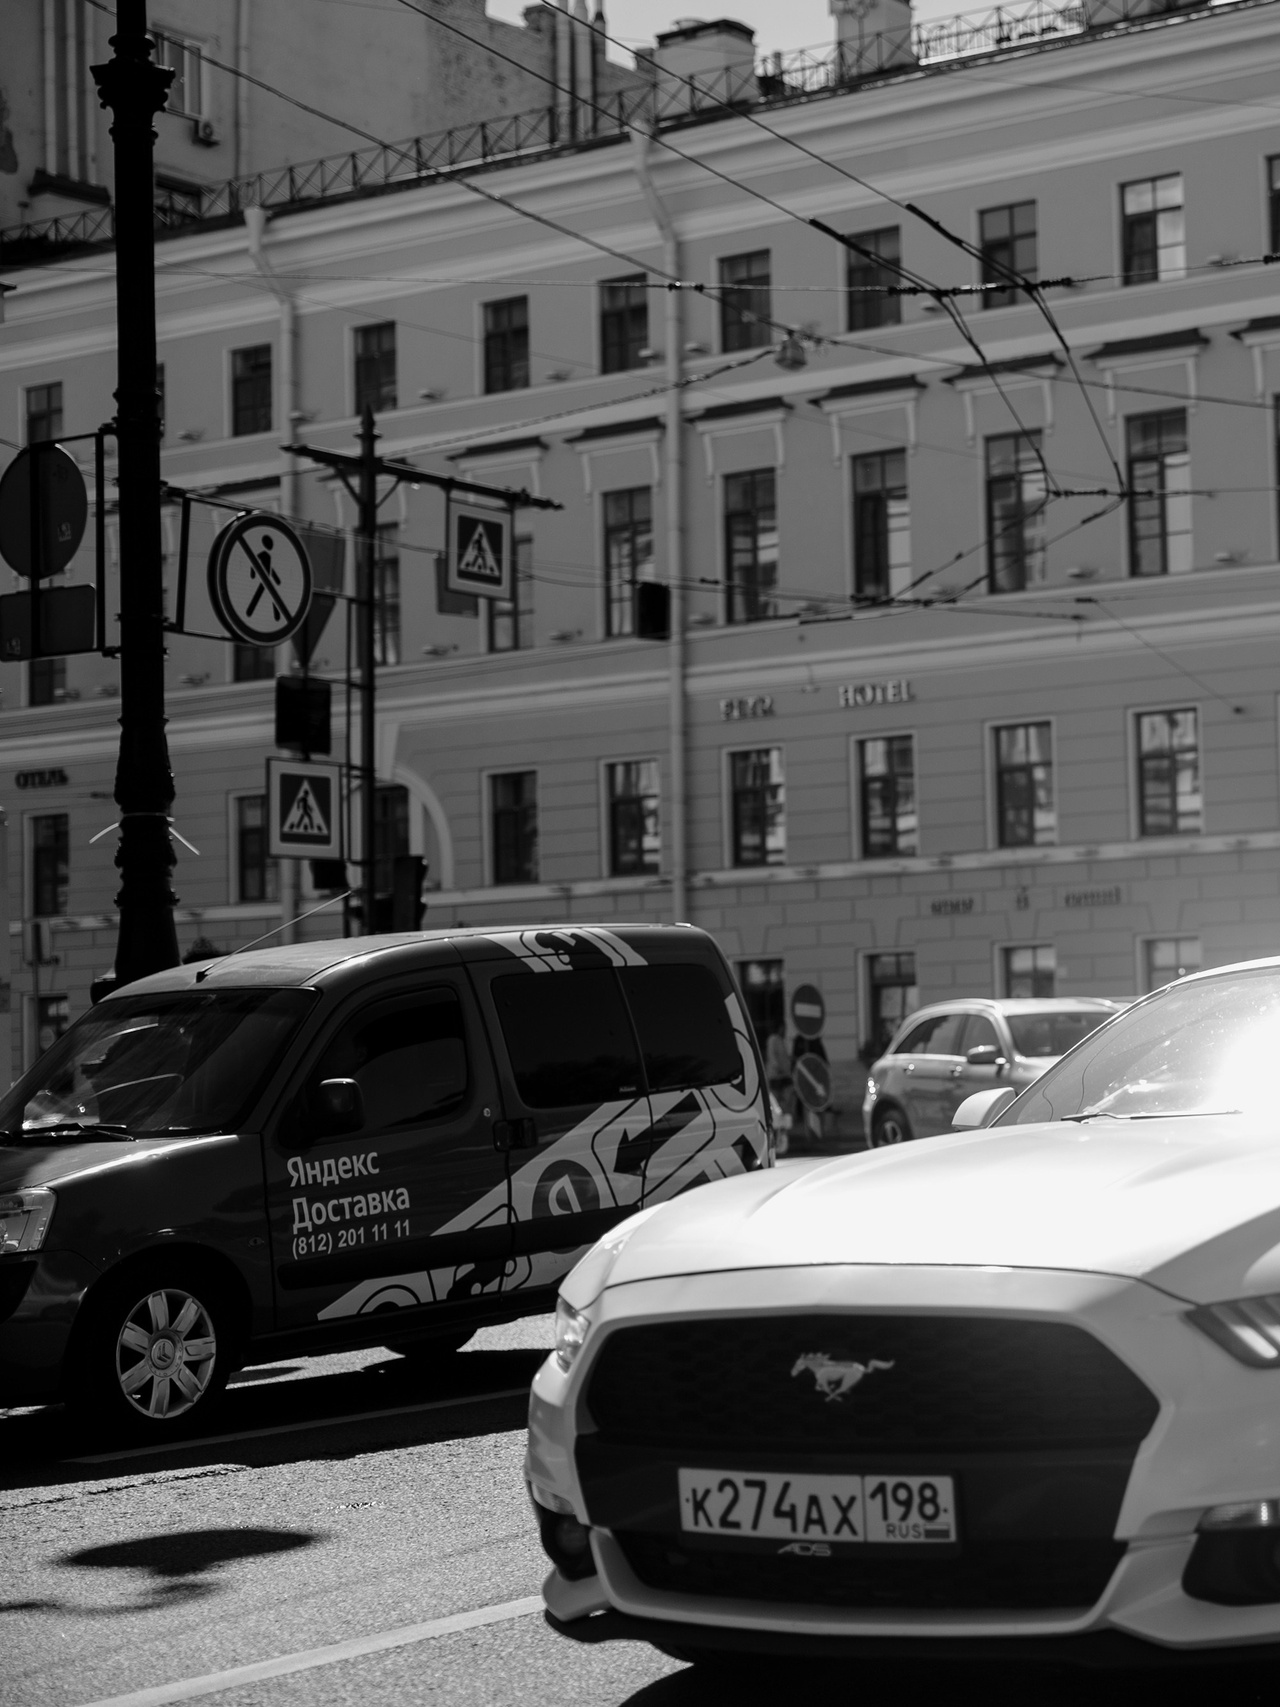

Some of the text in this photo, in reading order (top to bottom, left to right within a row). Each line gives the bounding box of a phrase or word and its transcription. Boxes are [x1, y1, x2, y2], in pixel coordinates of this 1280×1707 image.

[838, 680, 916, 708] HOTEL
[287, 1152, 380, 1187] Яндекс
[292, 1187, 410, 1235] Доставка
[292, 1219, 410, 1260] (812) 201 11 11
[691, 1477, 941, 1537] К274АХ 198
[886, 1523, 923, 1539] RUS
